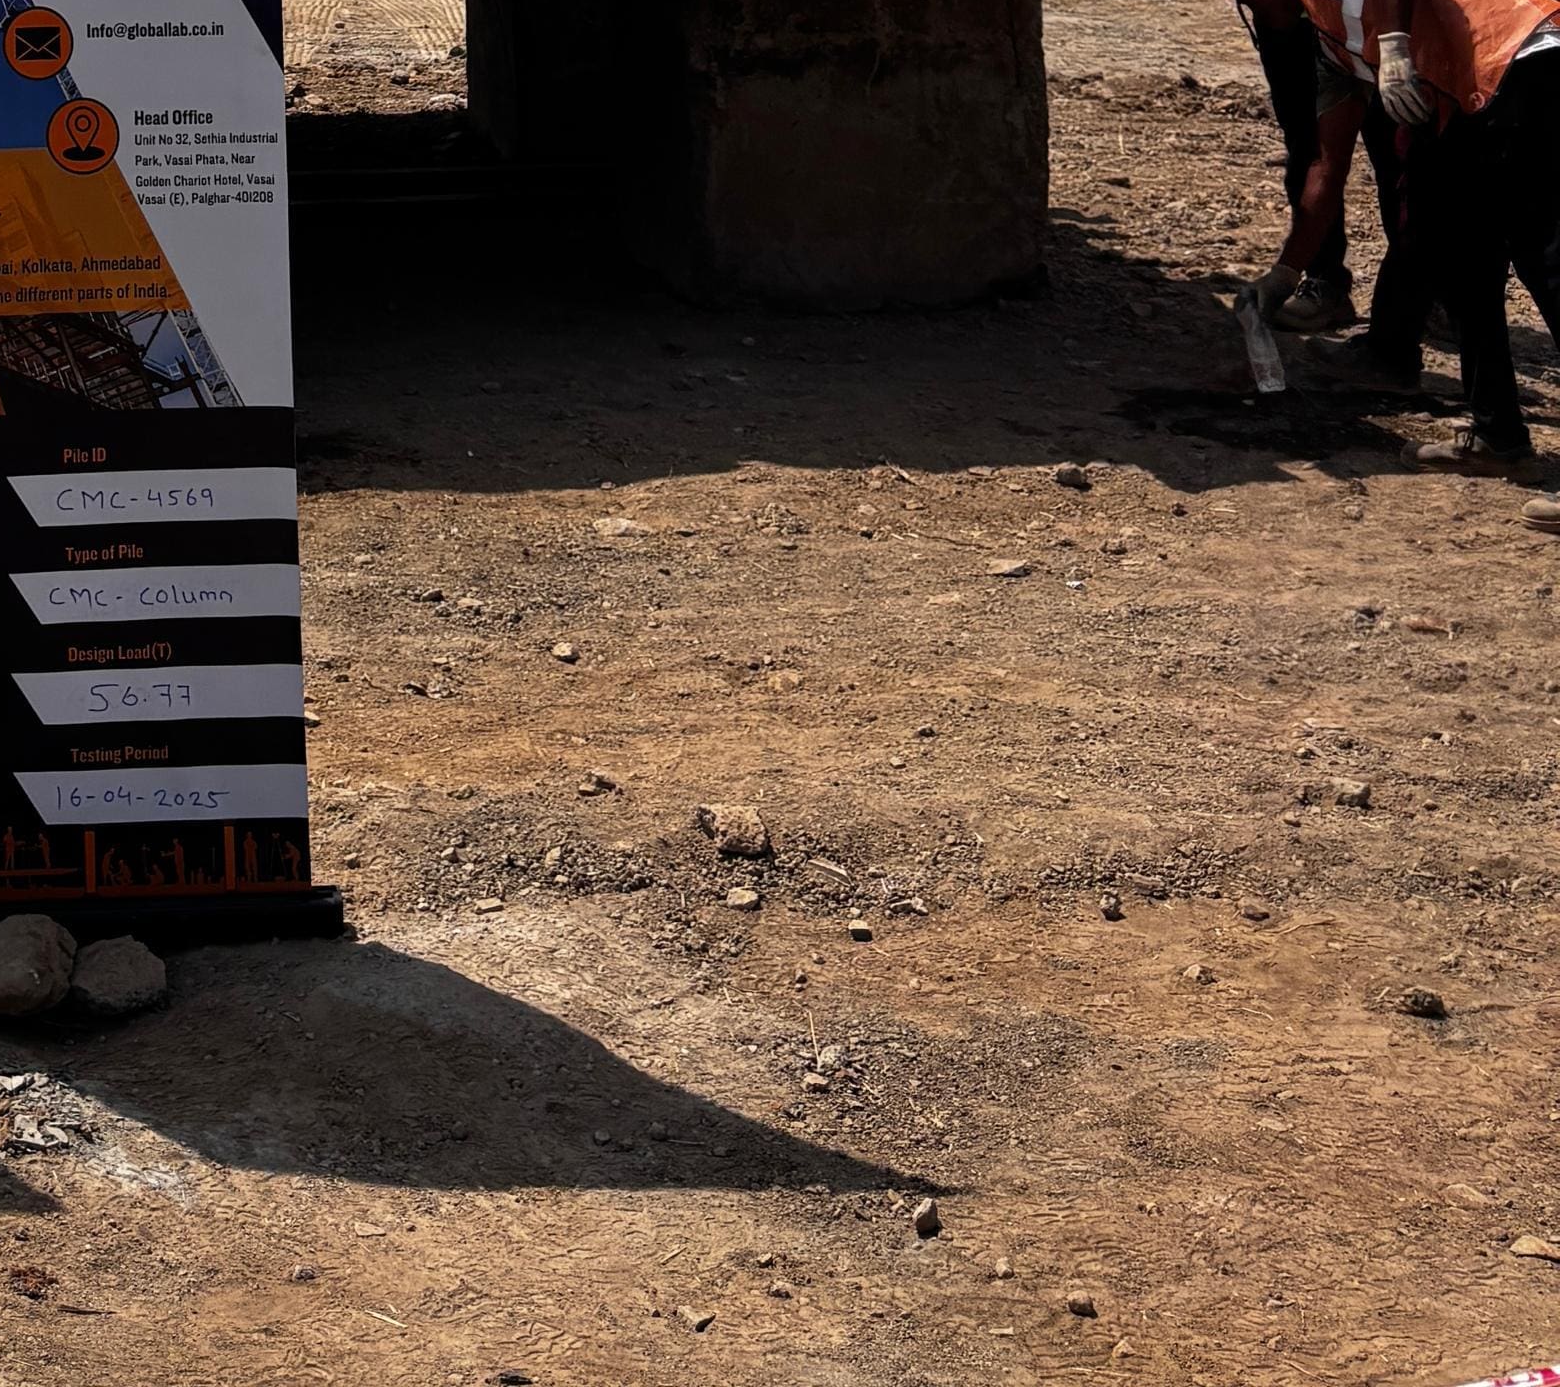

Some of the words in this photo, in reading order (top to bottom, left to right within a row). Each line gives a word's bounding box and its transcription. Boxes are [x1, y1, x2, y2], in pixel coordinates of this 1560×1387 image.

[86, 23, 224, 40] Info@globallab.co.in
[134, 111, 168, 126] Head
[172, 109, 213, 125] Office
[134, 134, 156, 146] Unit
[158, 133, 173, 145] No
[176, 133, 192, 147] 32,
[229, 132, 278, 144] Industrial
[135, 155, 162, 167] Park,
[164, 154, 192, 166] Vasai
[195, 153, 229, 166] Phata,
[230, 153, 256, 165] Near
[135, 175, 172, 187] Golden
[174, 174, 212, 187] Chariot
[214, 174, 244, 187] Hotel,
[246, 173, 275, 185] Vasai
[137, 193, 166, 205] Vasai
[191, 191, 274, 207] Palghar-401208
[21, 258, 77, 275] Kolkata,
[80, 255, 161, 272] Ahmedabad
[16, 285, 74, 303] different
[77, 286, 113, 303] parts
[116, 284, 130, 299] of
[134, 283, 171, 299] India.
[63, 449, 89, 463] Pile
[92, 447, 106, 463] ID
[65, 547, 98, 565] Type
[102, 545, 116, 561] of
[118, 545, 144, 559] Pile
[68, 645, 114, 663] Design
[88, 684, 191, 712] 56.77
[70, 748, 122, 765] Testing
[124, 745, 169, 761] Period
[58, 786, 230, 810] 16-04-2025
